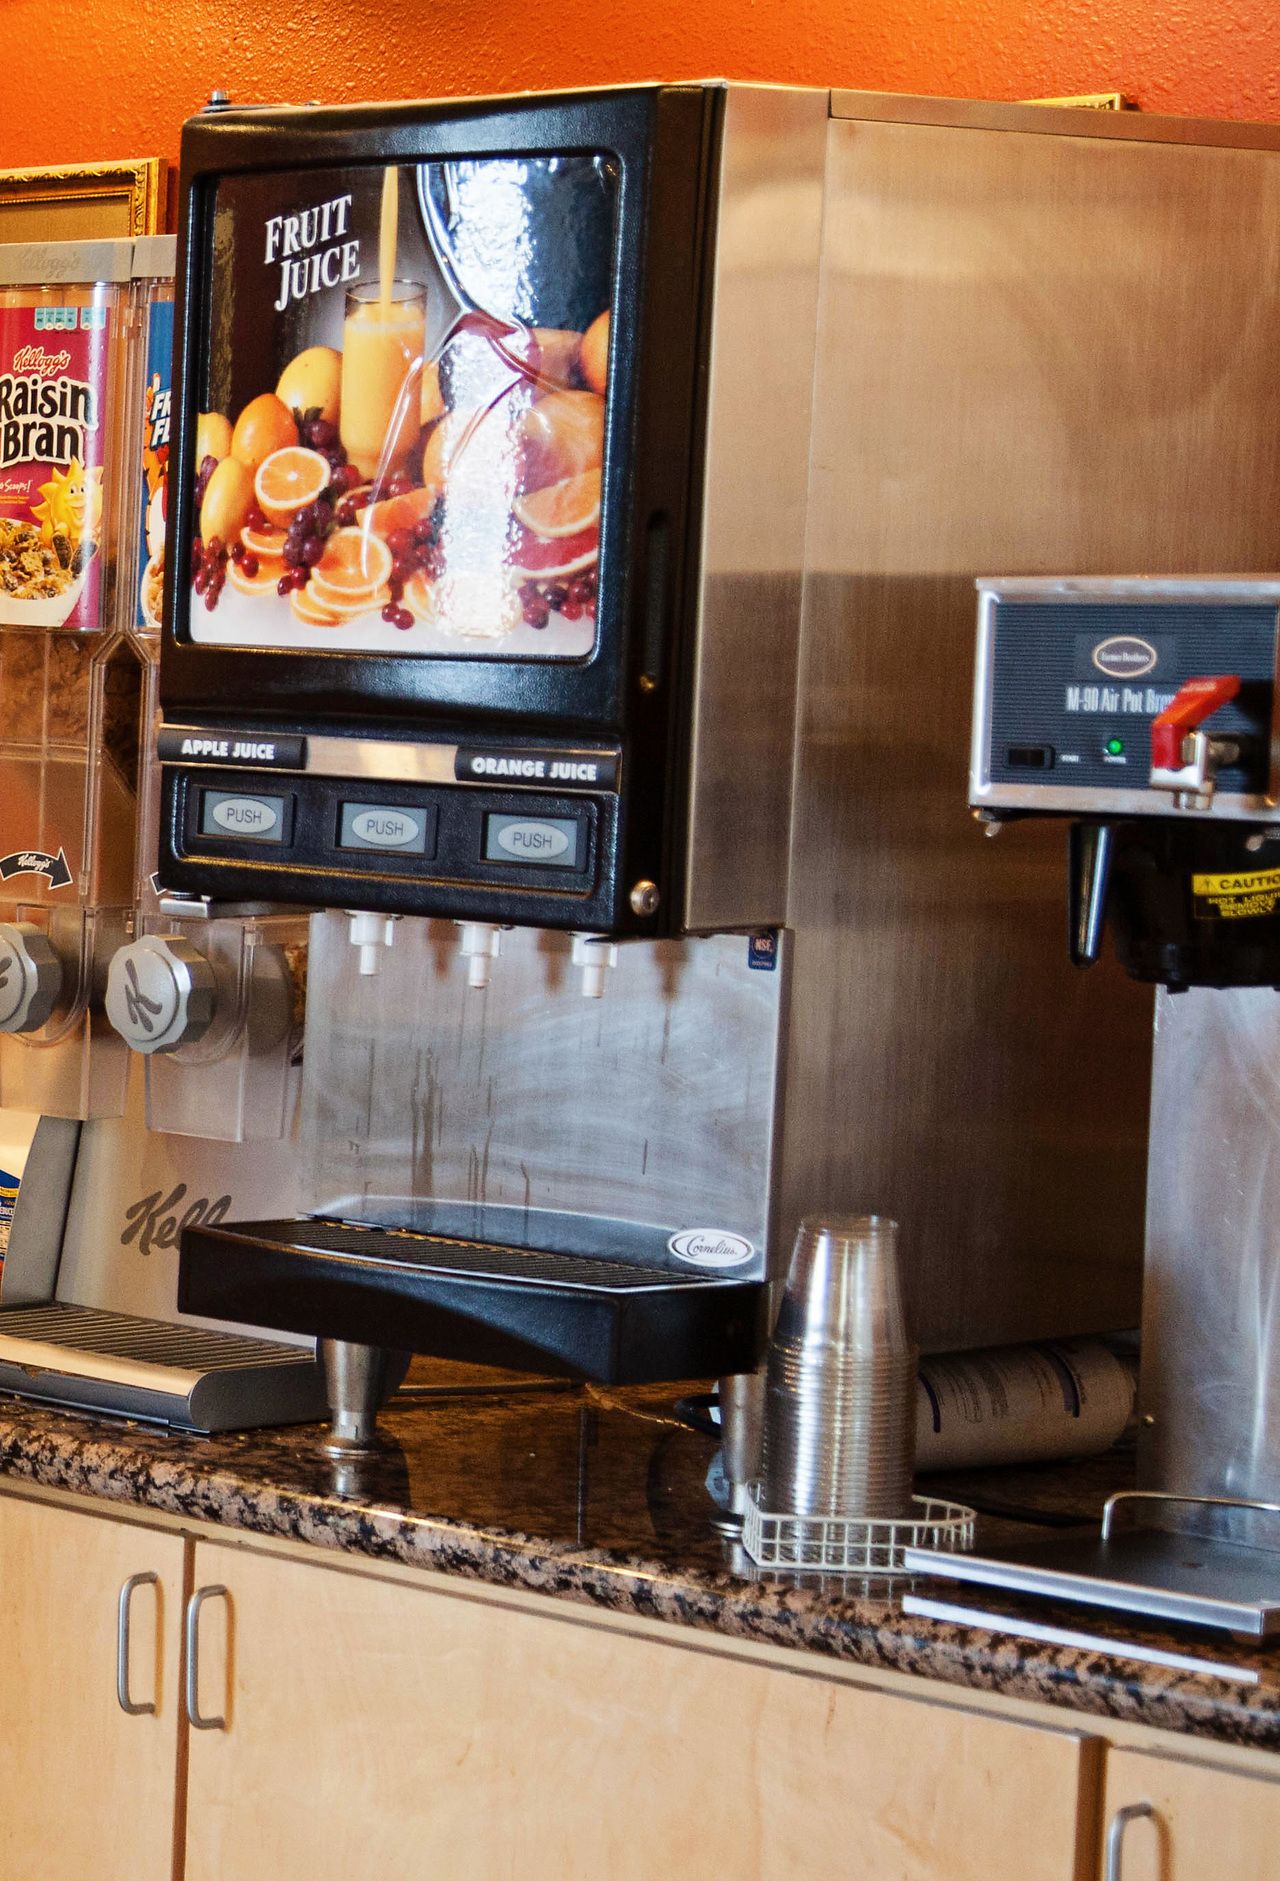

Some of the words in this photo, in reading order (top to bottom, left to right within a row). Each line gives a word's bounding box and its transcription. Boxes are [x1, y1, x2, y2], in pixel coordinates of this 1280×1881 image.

[264, 195, 351, 264] FRUIT
[274, 240, 360, 310] JUICE
[14, 346, 70, 375] Kellogg's
[2, 420, 80, 463] Bran
[4, 479, 32, 493] Scoops!
[1066, 686, 1099, 712] M-90
[1101, 688, 1120, 712] Air
[1122, 687, 1143, 713] Pot
[181, 738, 228, 757] APPLE
[233, 741, 275, 760] JUICE
[471, 757, 544, 778] ORANGE
[548, 761, 597, 781] JUICE
[226, 807, 263, 825] PUSH
[366, 819, 404, 837] PUSH
[512, 831, 553, 850] PUSH
[18, 854, 50, 871] Kellogg's
[125, 958, 163, 1033] K
[687, 1235, 735, 1257] Cornelius
